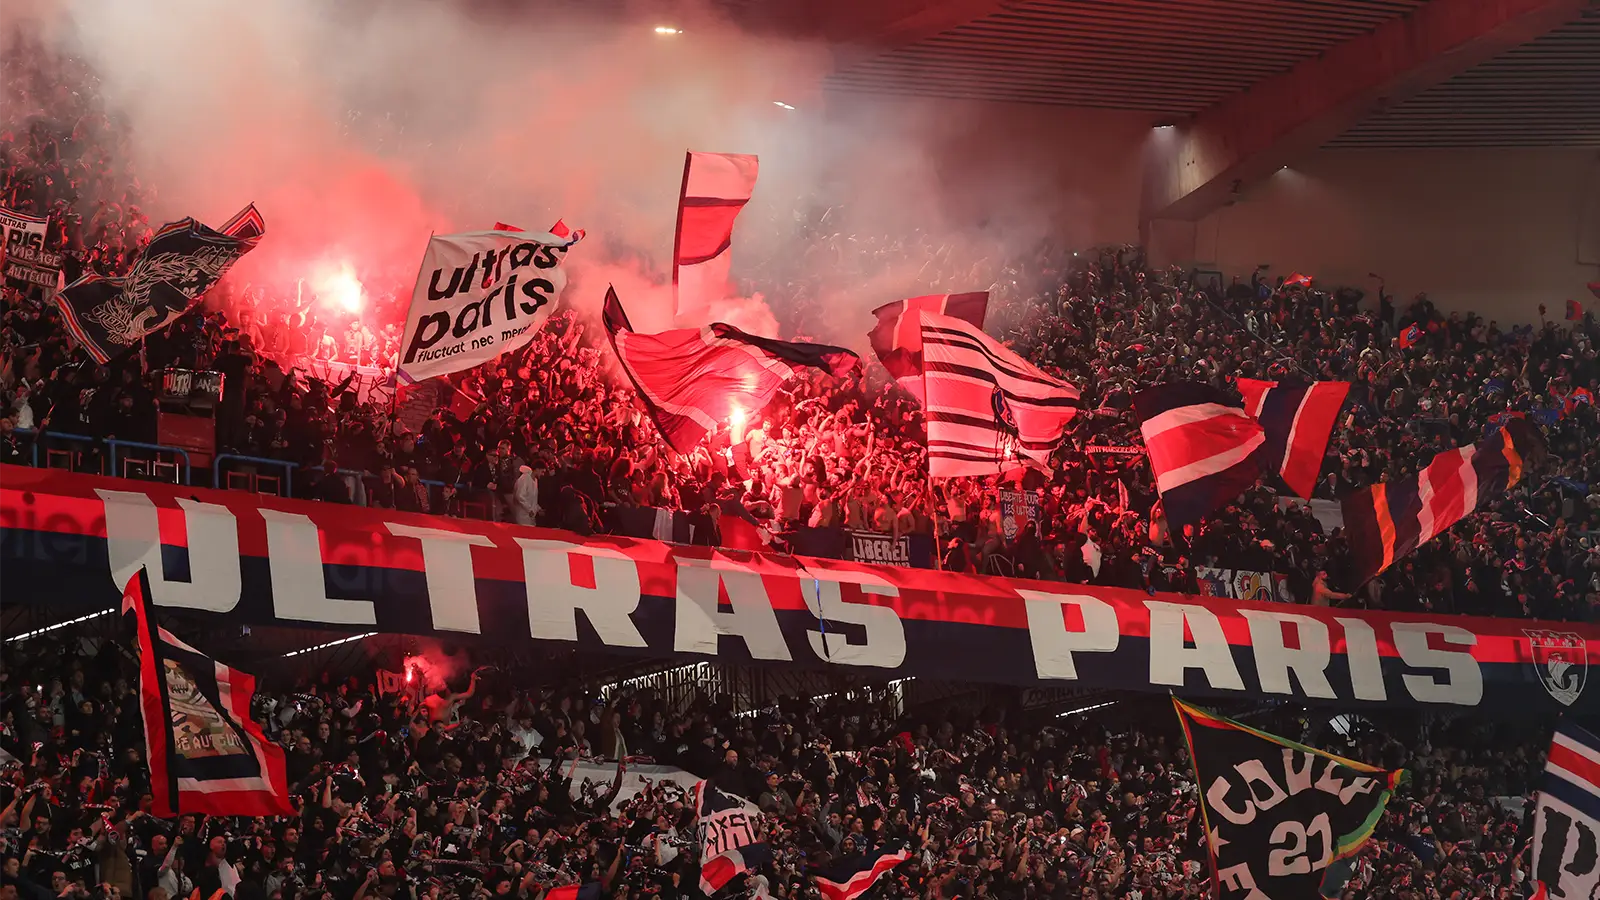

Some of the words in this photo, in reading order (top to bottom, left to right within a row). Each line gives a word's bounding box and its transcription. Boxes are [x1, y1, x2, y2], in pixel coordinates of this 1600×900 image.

[11, 245, 61, 267] VIRAGE
[427, 243, 568, 301] ultras
[402, 274, 555, 364] paris
[417, 342, 466, 363] fluctuat
[471, 334, 494, 350] nec
[1004, 504, 1014, 515] LES
[94, 488, 907, 668] ULTRAS
[1014, 588, 1484, 706] PARIS
[1268, 811, 1334, 877] 21
